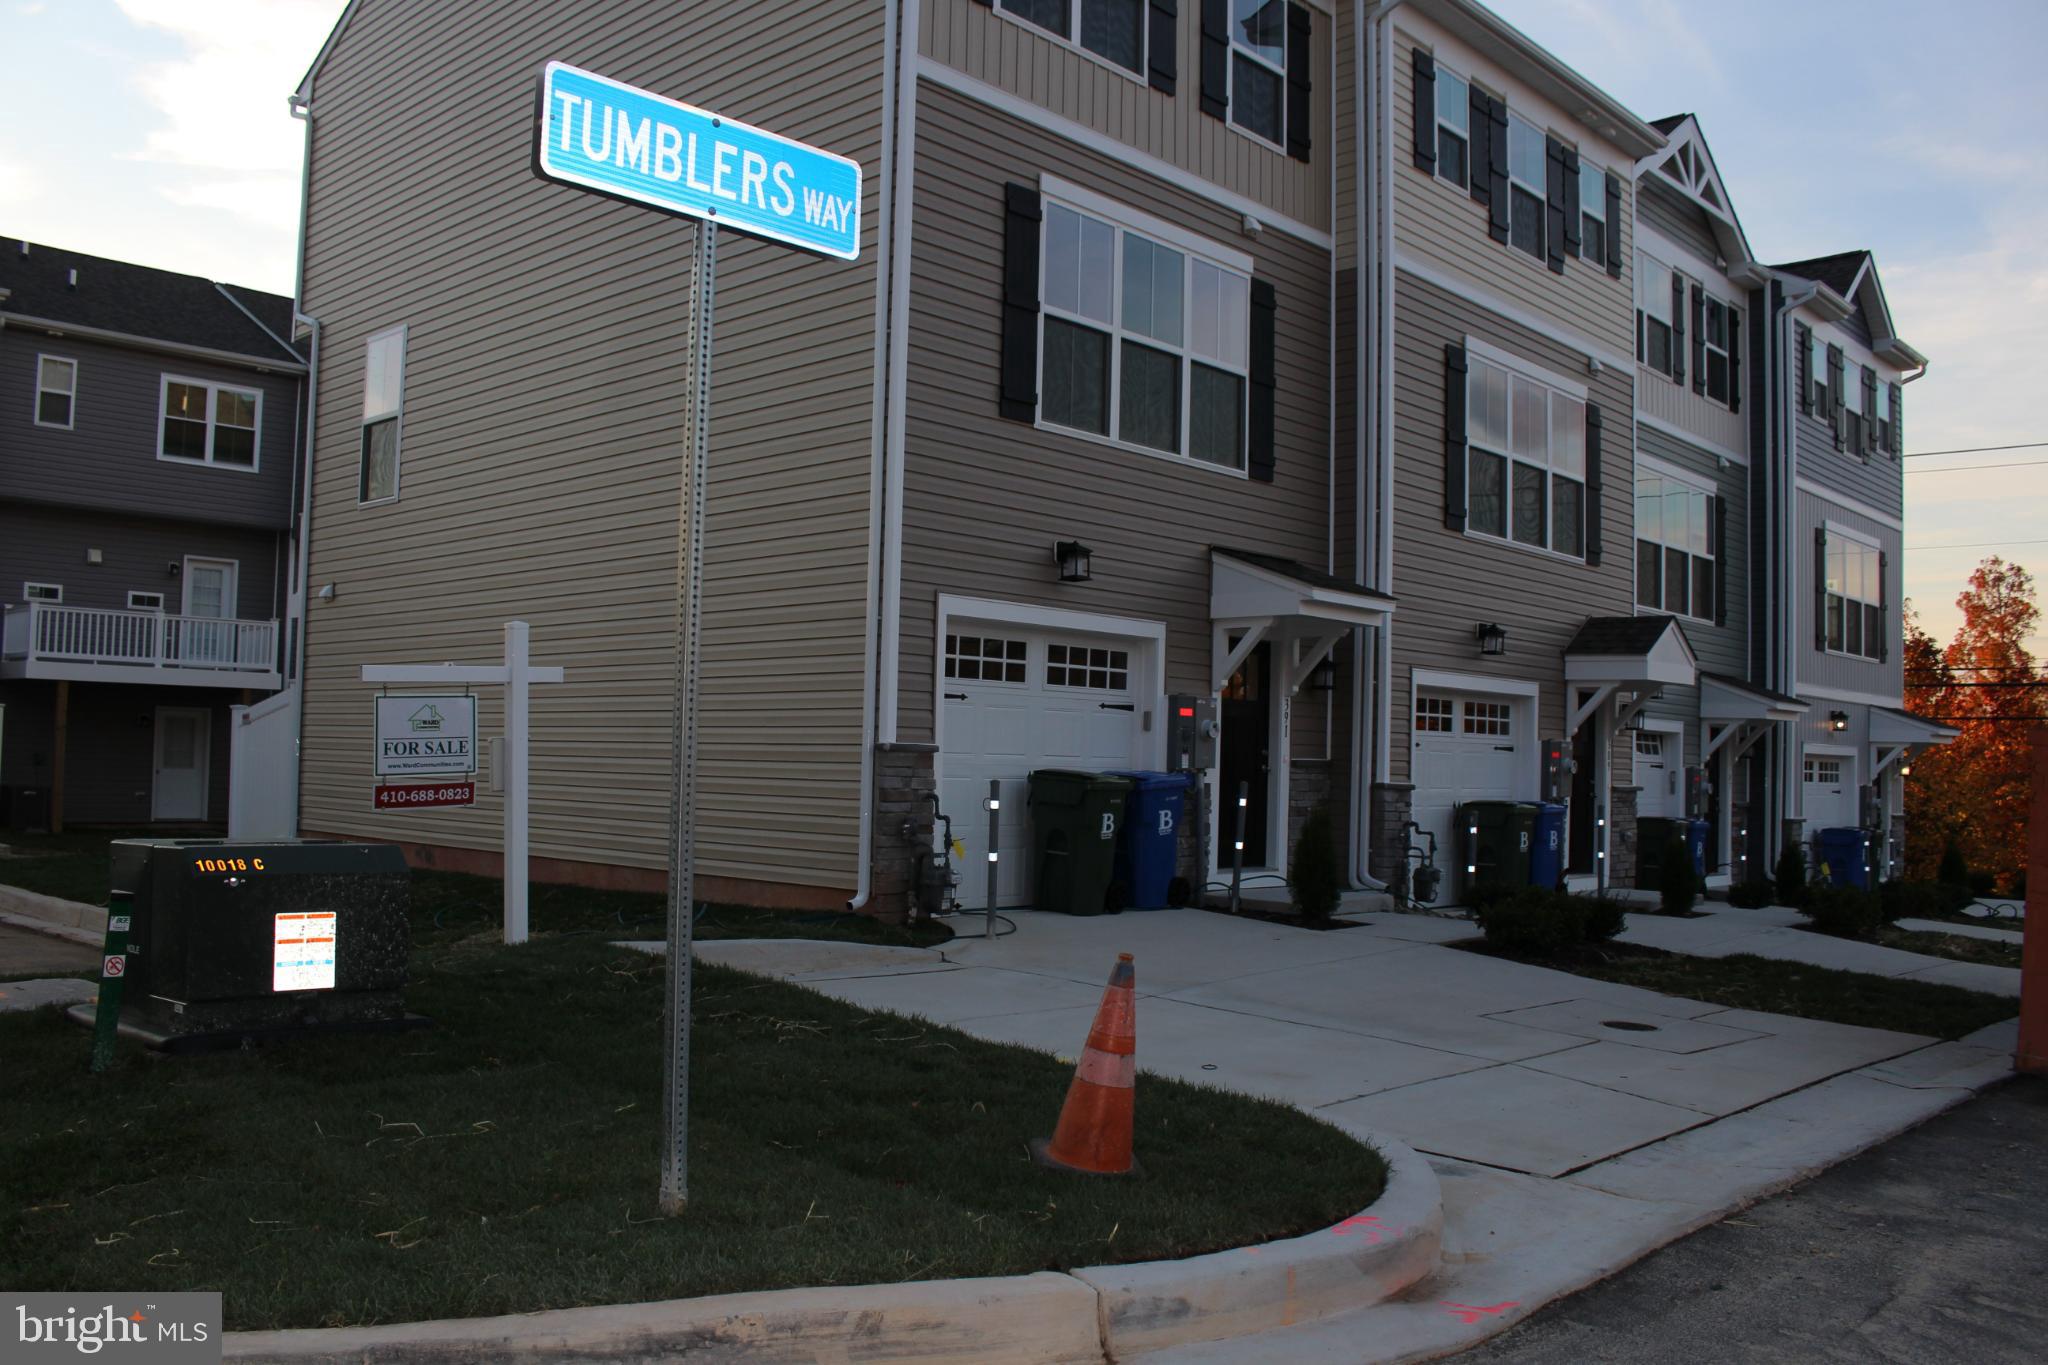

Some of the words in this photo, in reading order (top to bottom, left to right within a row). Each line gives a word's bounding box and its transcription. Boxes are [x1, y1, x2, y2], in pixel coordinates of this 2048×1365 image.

[554, 89, 796, 217] TUMBLERS
[803, 186, 853, 234] WAY
[383, 741, 419, 756] FOR
[424, 740, 469, 755] SALE
[380, 787, 470, 803] 410-688-0823
[1101, 812, 1114, 833] B
[1159, 809, 1173, 829] B
[1520, 831, 1529, 848] B
[195, 858, 247, 872] 10018
[253, 858, 265, 871] C
